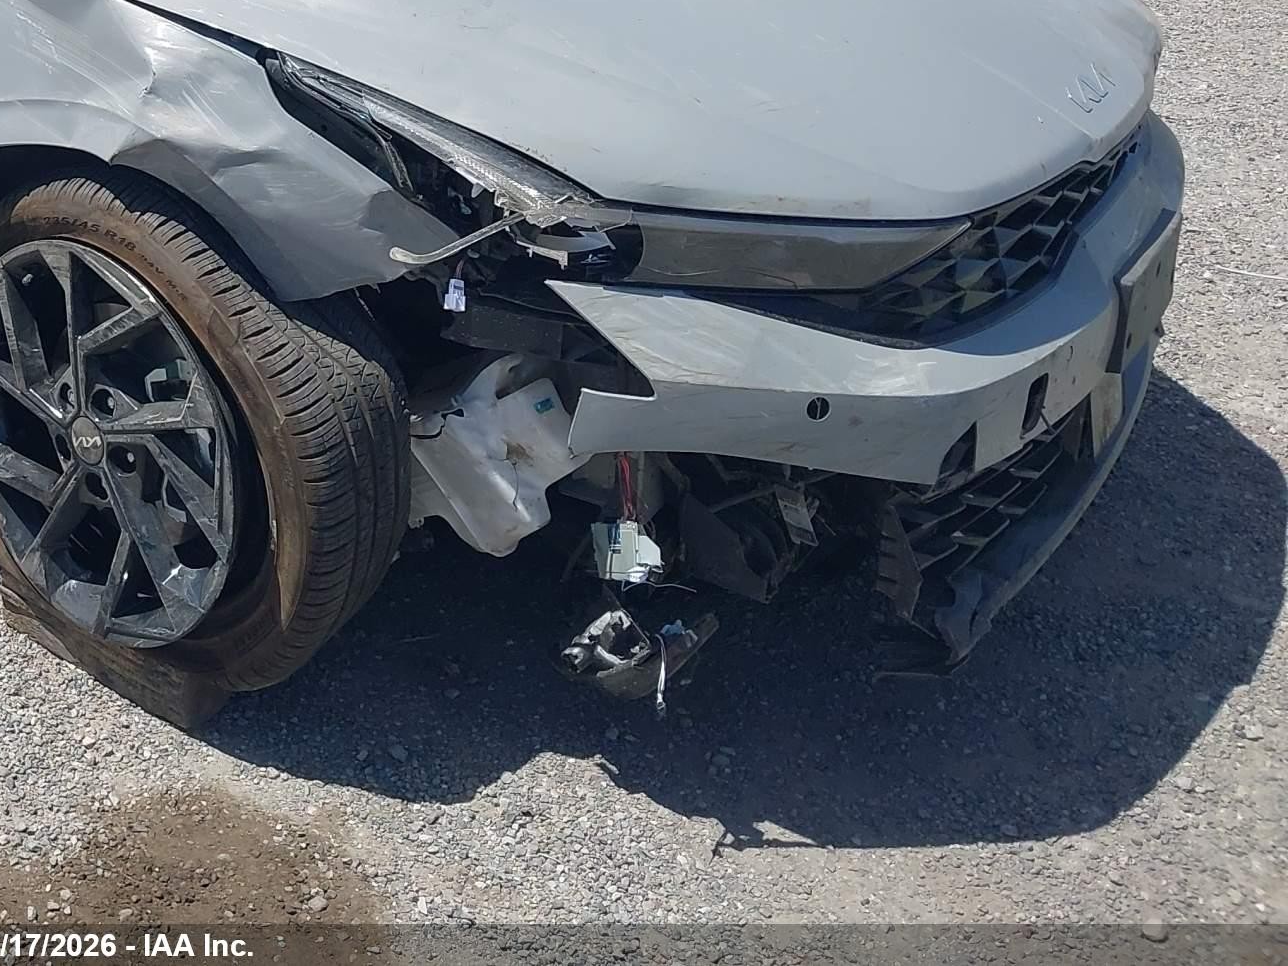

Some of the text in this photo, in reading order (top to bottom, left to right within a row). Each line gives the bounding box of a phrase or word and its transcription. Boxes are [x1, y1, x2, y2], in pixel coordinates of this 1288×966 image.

[1065, 62, 1116, 114] KIA
[43, 216, 101, 233] 235/45
[104, 229, 137, 252] R18
